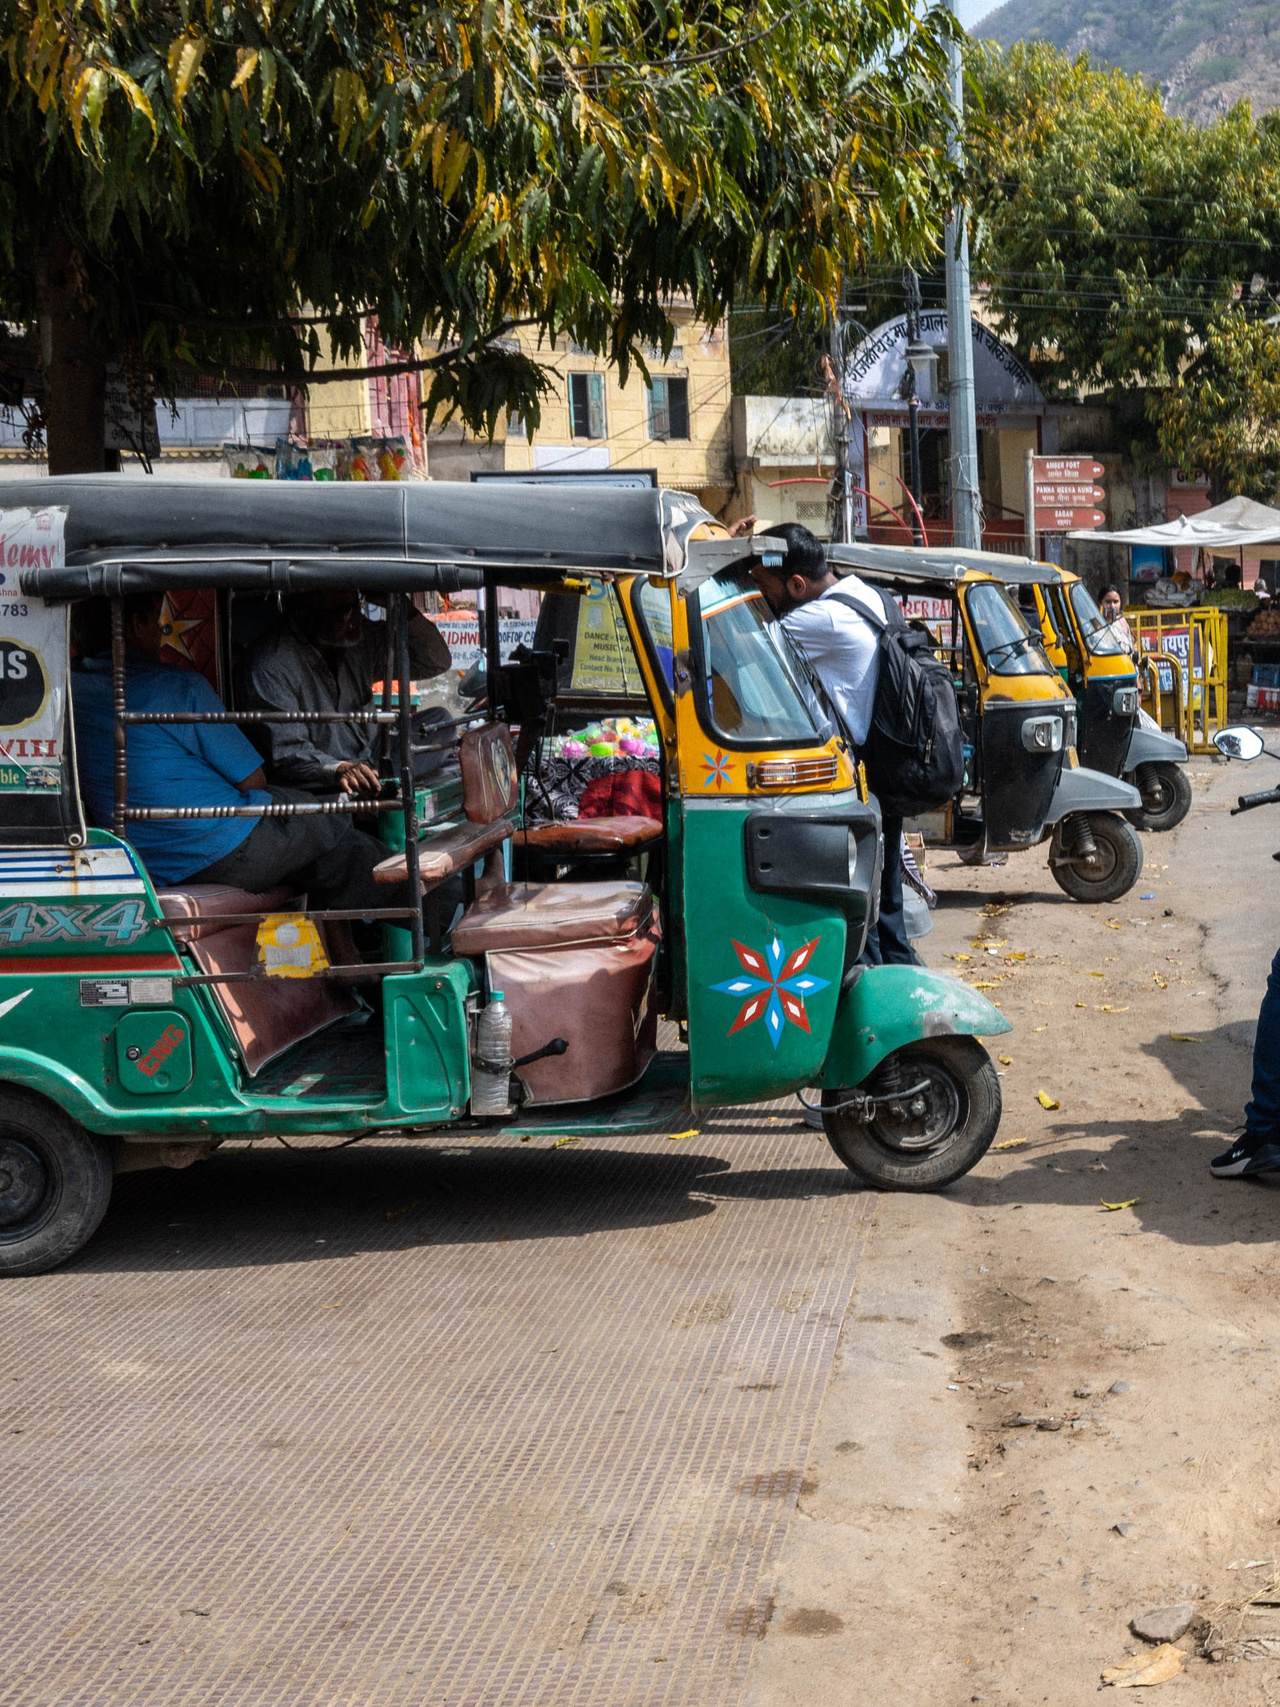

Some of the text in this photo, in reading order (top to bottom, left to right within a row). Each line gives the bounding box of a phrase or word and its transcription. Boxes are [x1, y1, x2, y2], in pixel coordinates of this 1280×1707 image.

[1046, 461, 1080, 469] AMBER FORT
[0, 604, 28, 617] 783
[585, 632, 609, 641] DANCE
[593, 643, 616, 652] MUSIC
[0, 769, 20, 785] ble
[137, 1024, 185, 1077] CNG
